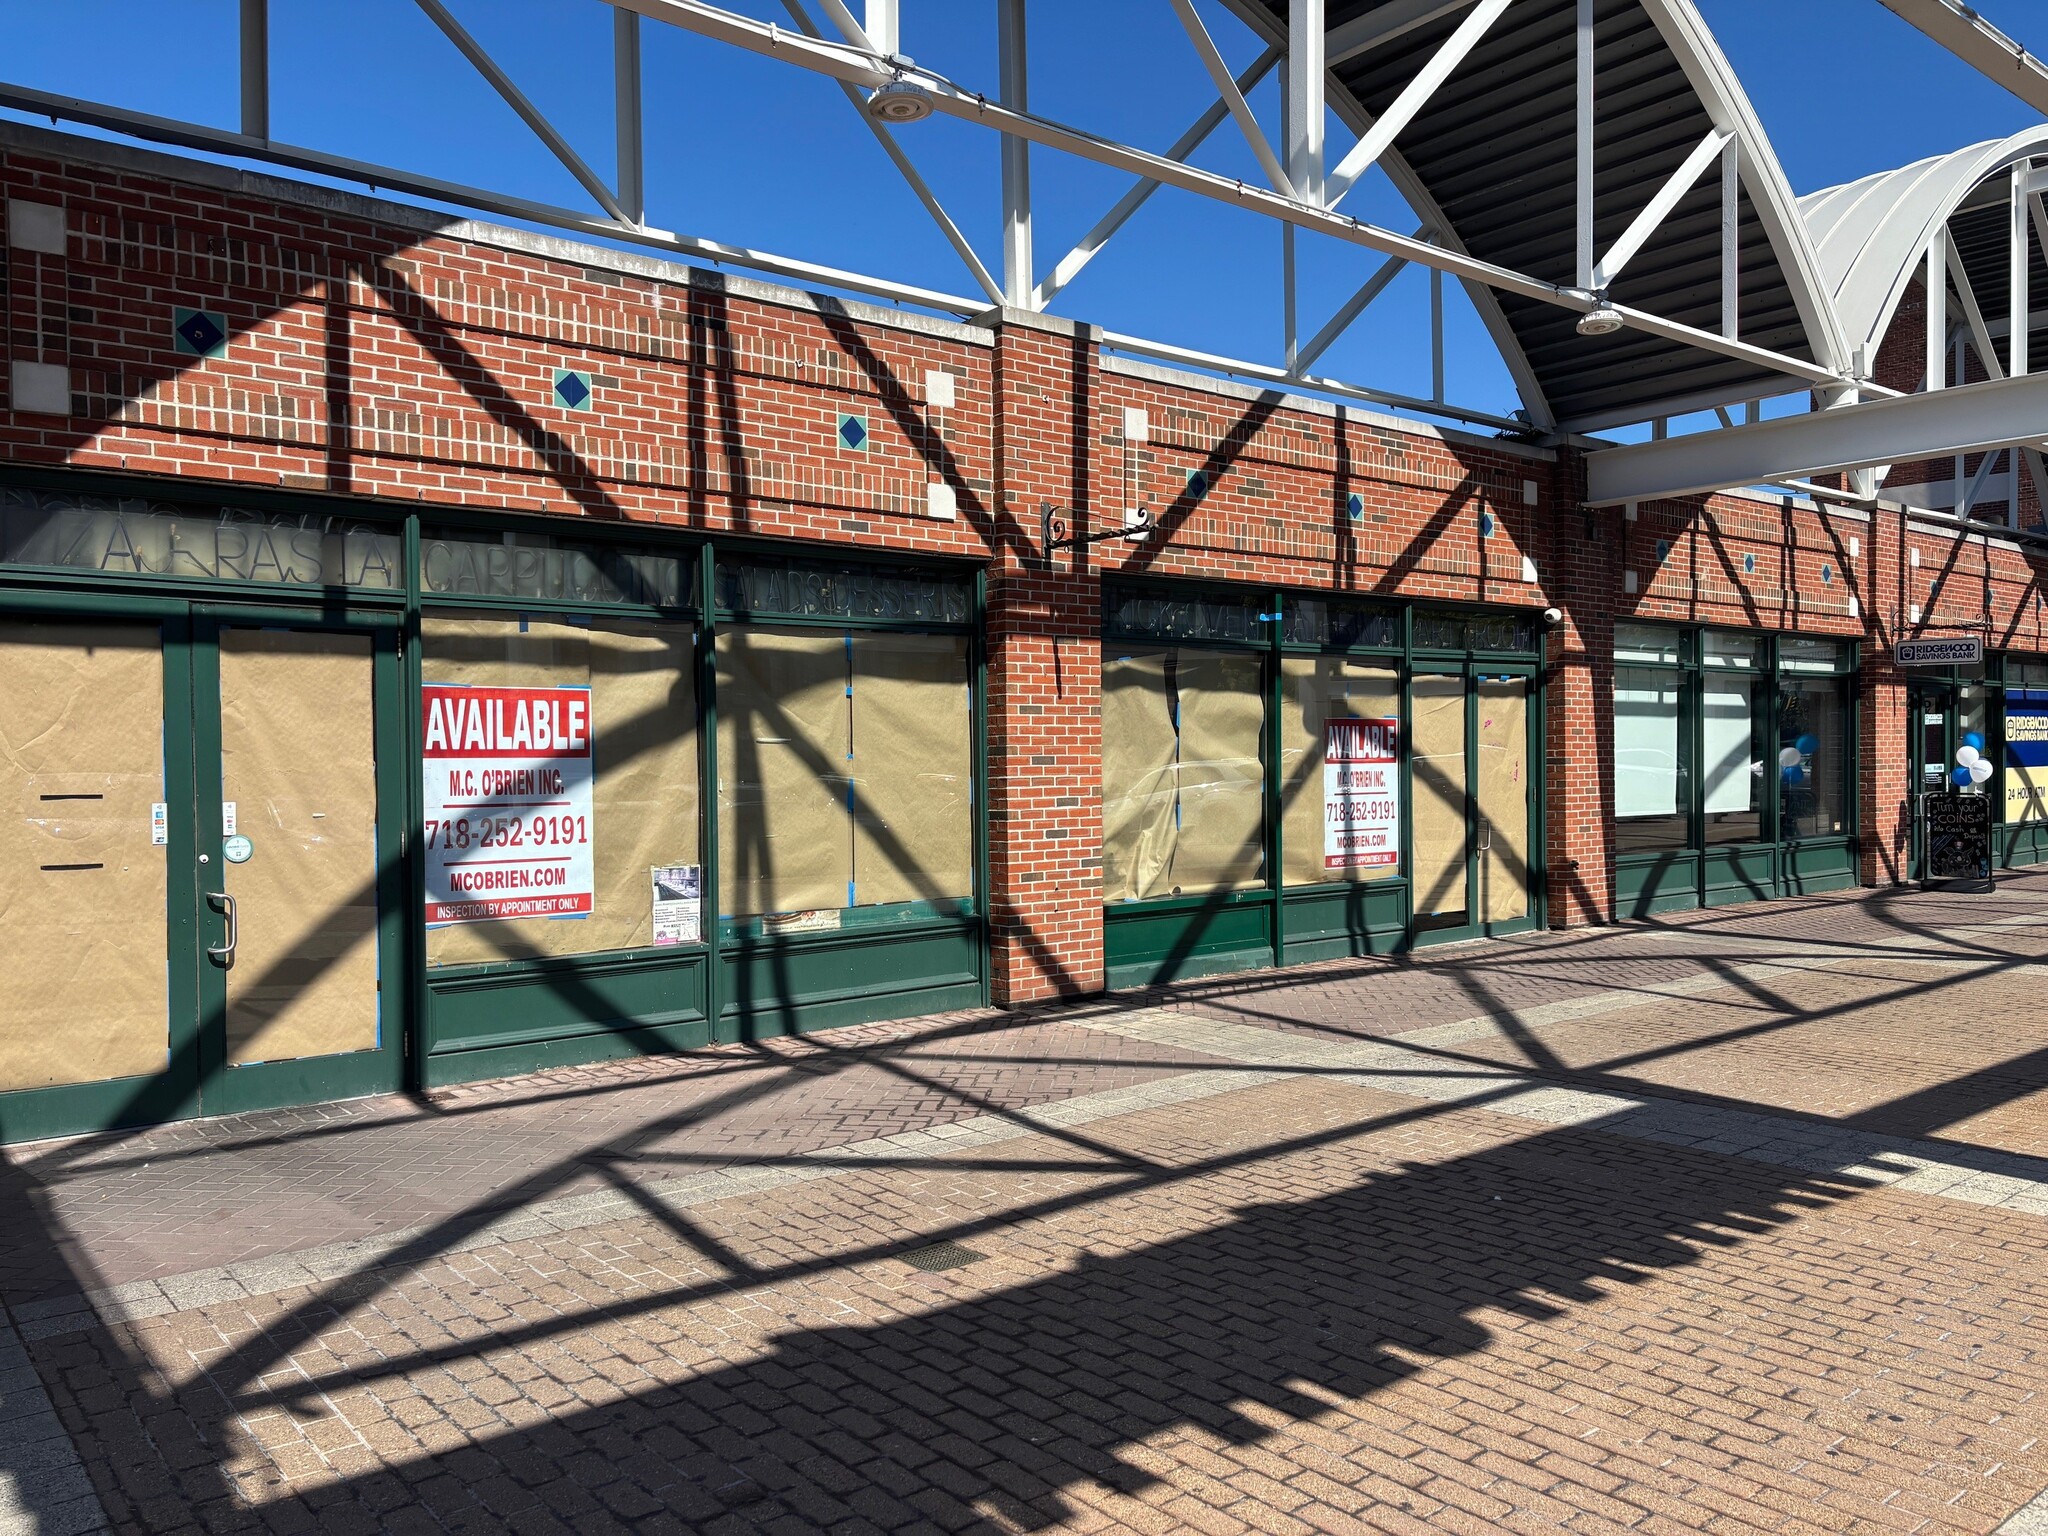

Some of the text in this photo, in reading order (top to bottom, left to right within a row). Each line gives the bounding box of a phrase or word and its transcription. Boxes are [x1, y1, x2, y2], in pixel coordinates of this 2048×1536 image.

[1916, 643, 1975, 653] RIDGEWOOD
[425, 698, 585, 750] AVAILABLE
[1326, 725, 1395, 759] AVAILABLE
[450, 769, 564, 796] M.C. O'BRIEN INC.
[1350, 771, 1372, 788] O'BRIEN
[1374, 771, 1386, 787] INC.
[2008, 788, 2015, 800] 24
[2017, 788, 2032, 799] HOUR
[1327, 801, 1395, 822] 718-252-9191
[1959, 804, 1978, 815] your
[425, 815, 587, 850] 718-252-9191
[1337, 834, 1387, 848] MCOBRIEN.COM
[450, 867, 566, 892] MCOBRIEN.COM
[437, 897, 579, 919] INSPECTION BY APPOINTMENT ONLY
